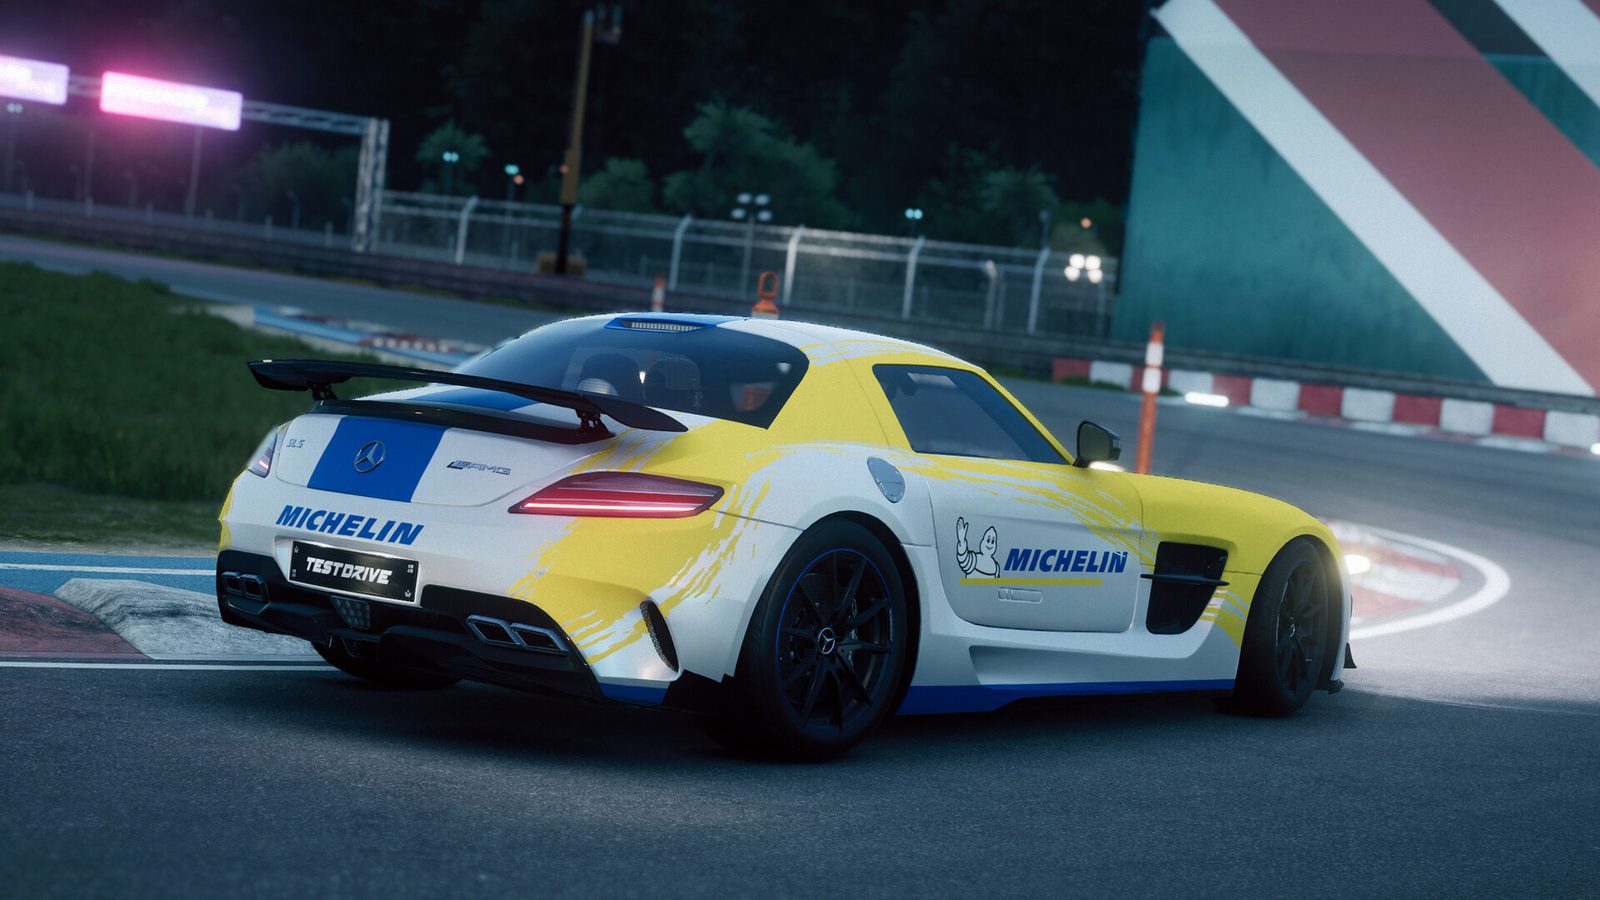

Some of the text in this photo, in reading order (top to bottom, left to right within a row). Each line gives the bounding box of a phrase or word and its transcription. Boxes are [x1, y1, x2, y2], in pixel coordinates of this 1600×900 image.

[286, 438, 306, 449] SLS
[467, 462, 512, 476] AMG
[275, 504, 424, 546] MICHELIN
[1003, 548, 1129, 574] MICHELIN
